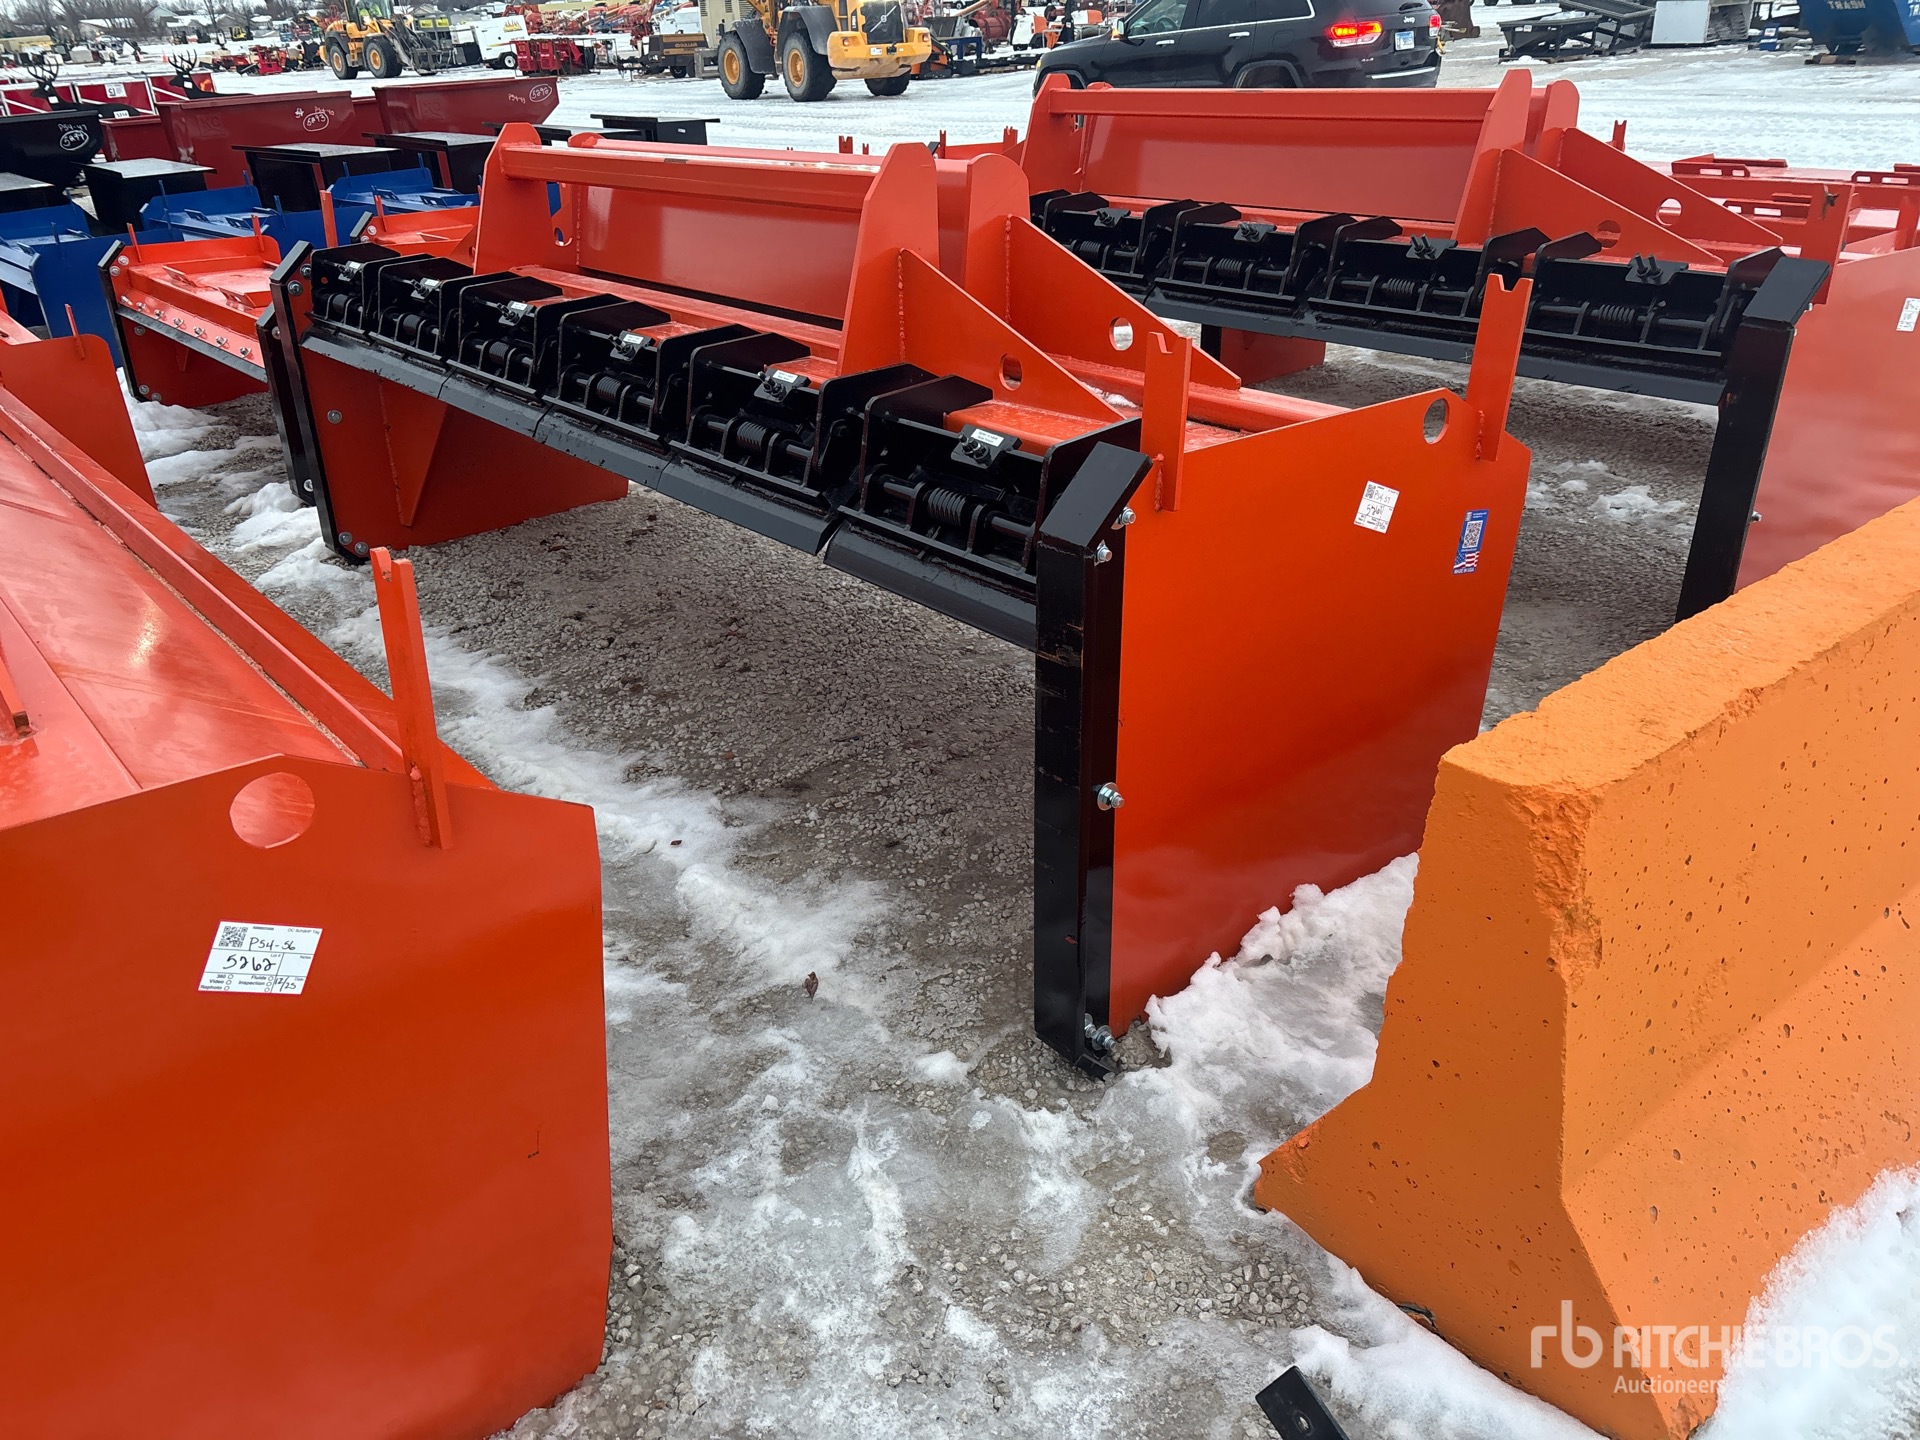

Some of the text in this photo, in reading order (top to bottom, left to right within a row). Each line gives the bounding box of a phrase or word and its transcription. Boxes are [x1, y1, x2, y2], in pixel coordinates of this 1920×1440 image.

[1827, 0, 1866, 10] TRASH
[1909, 4, 1920, 17] TR
[1403, 16, 1416, 24] Jeep
[248, 936, 296, 951] P54-56
[222, 953, 277, 972] 5262
